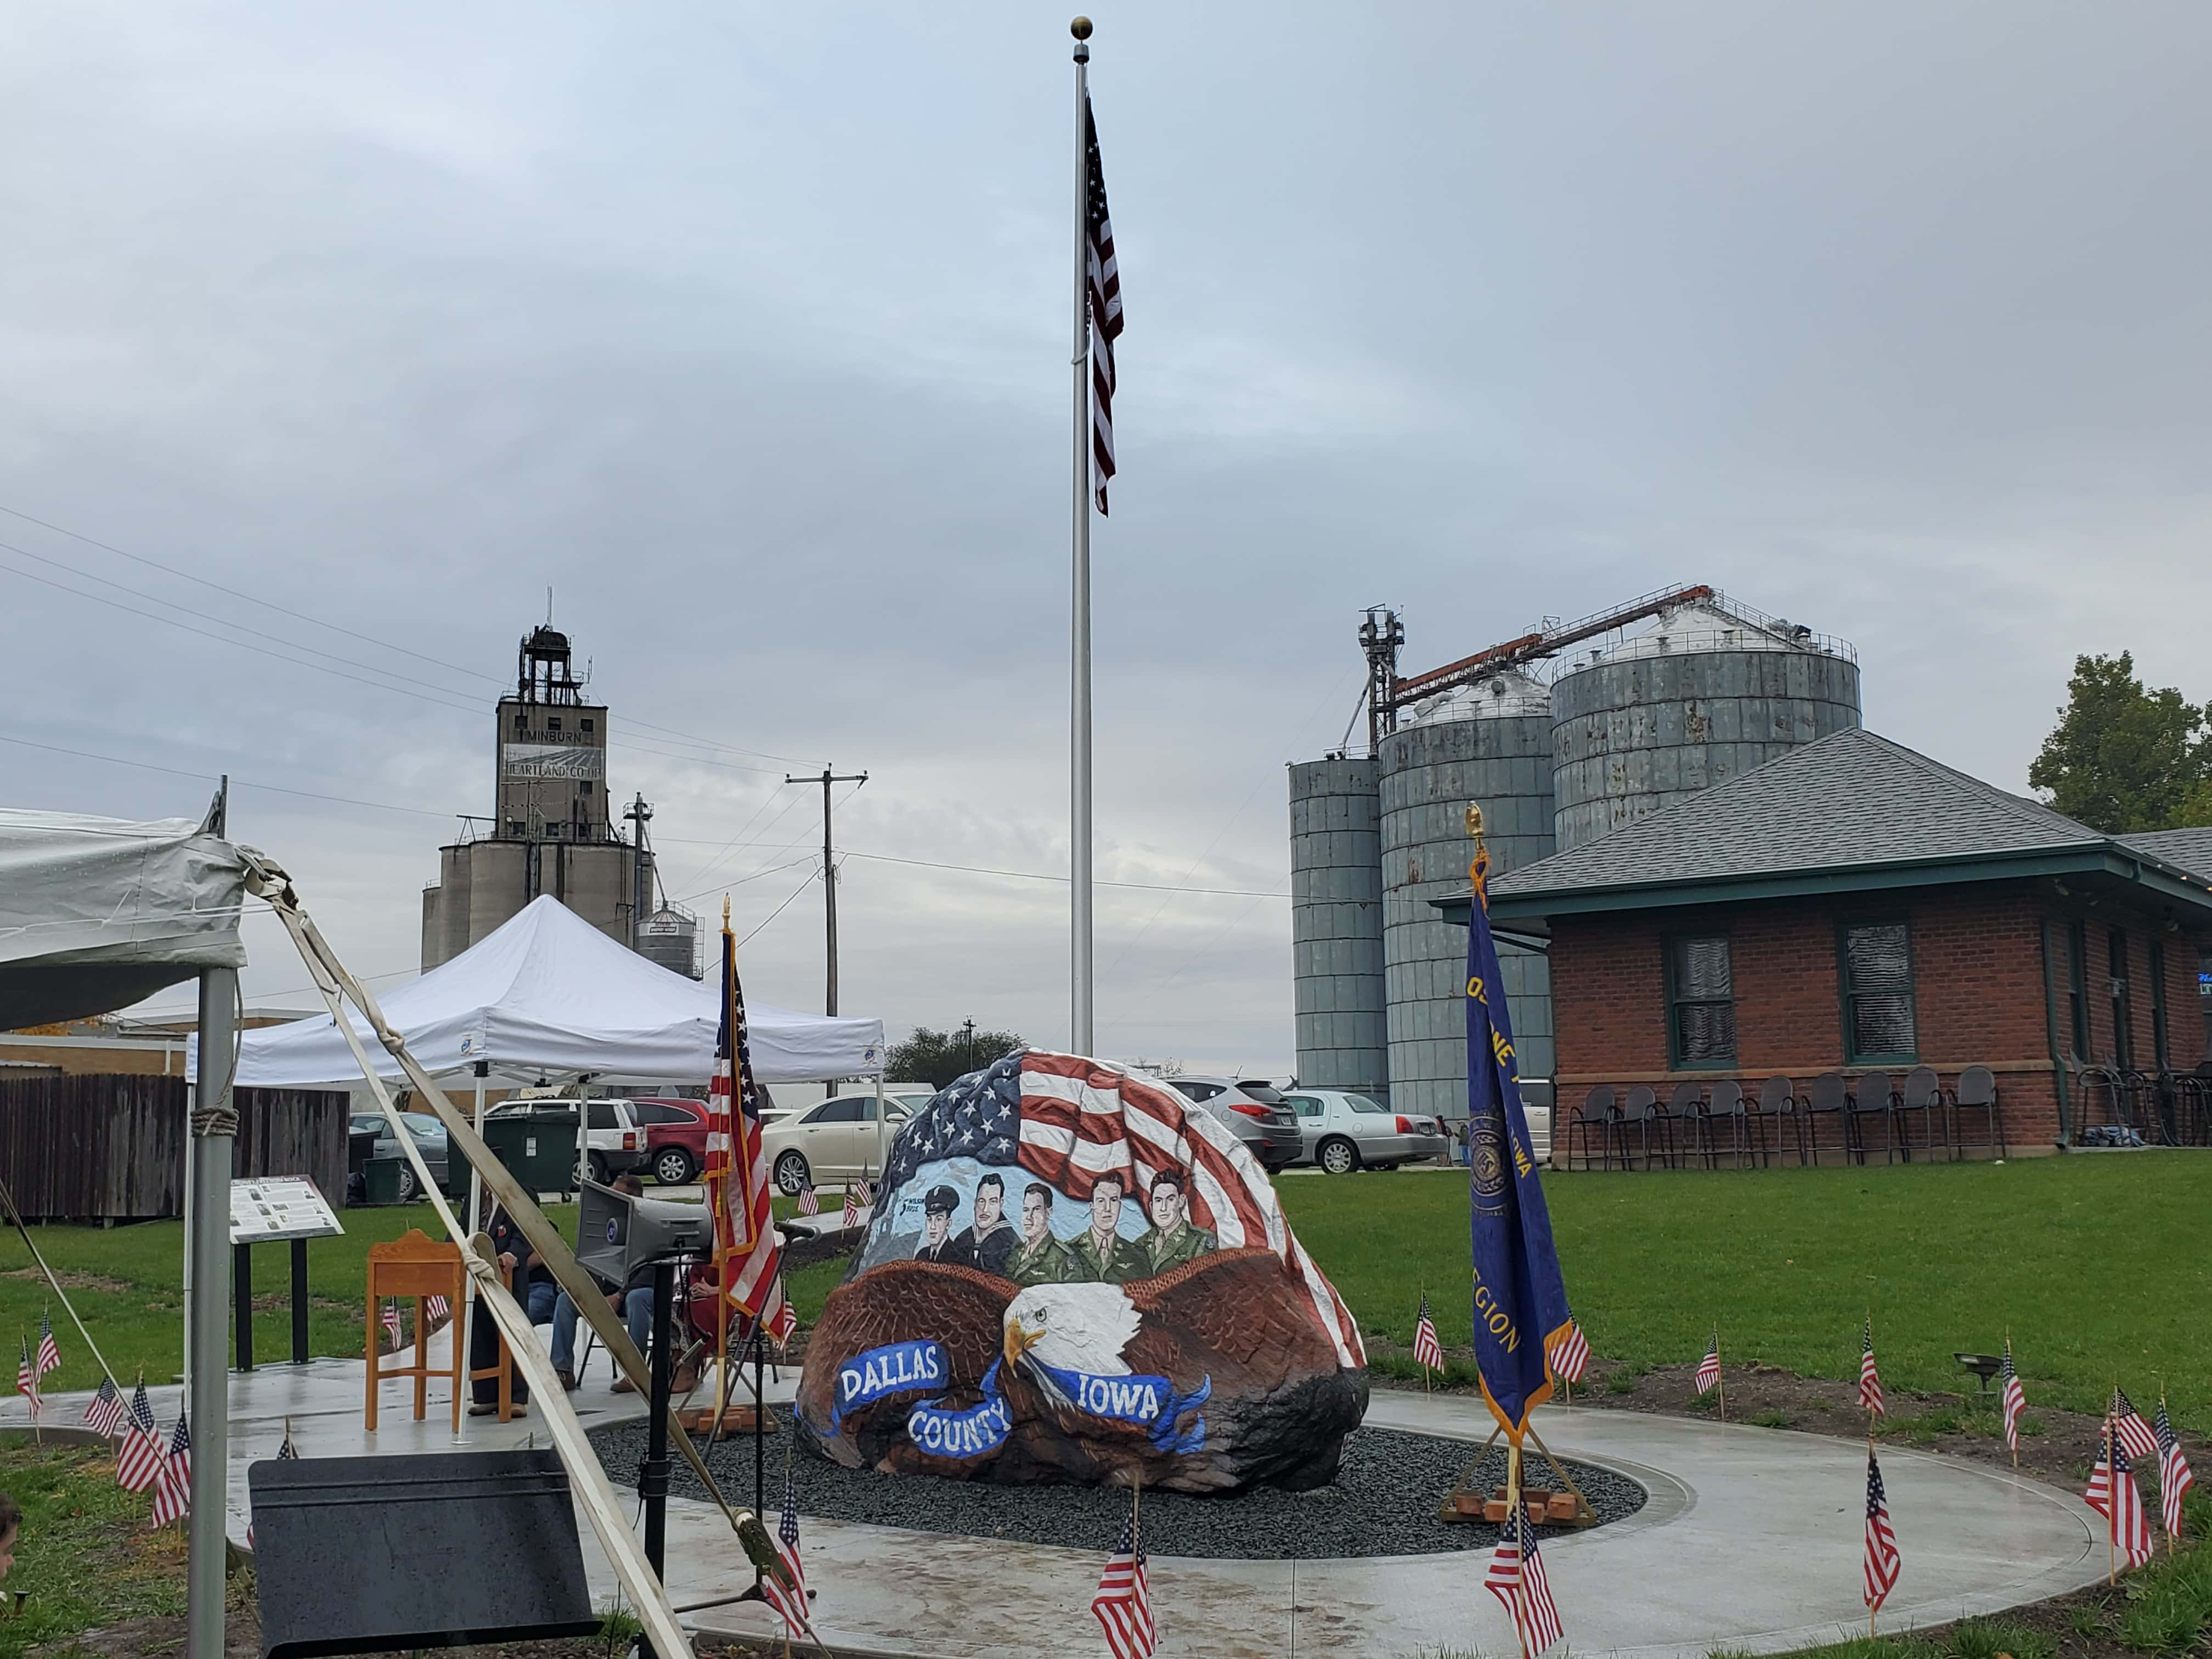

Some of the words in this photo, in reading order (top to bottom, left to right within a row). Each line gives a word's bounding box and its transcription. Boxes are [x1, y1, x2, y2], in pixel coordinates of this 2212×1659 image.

[528, 730, 582, 742] MINBURN
[507, 764, 566, 777] HEARTLAND
[841, 1346, 939, 1401] DALLAS
[1077, 1374, 1159, 1419] IOWA
[908, 1397, 1012, 1452] COUNTY
